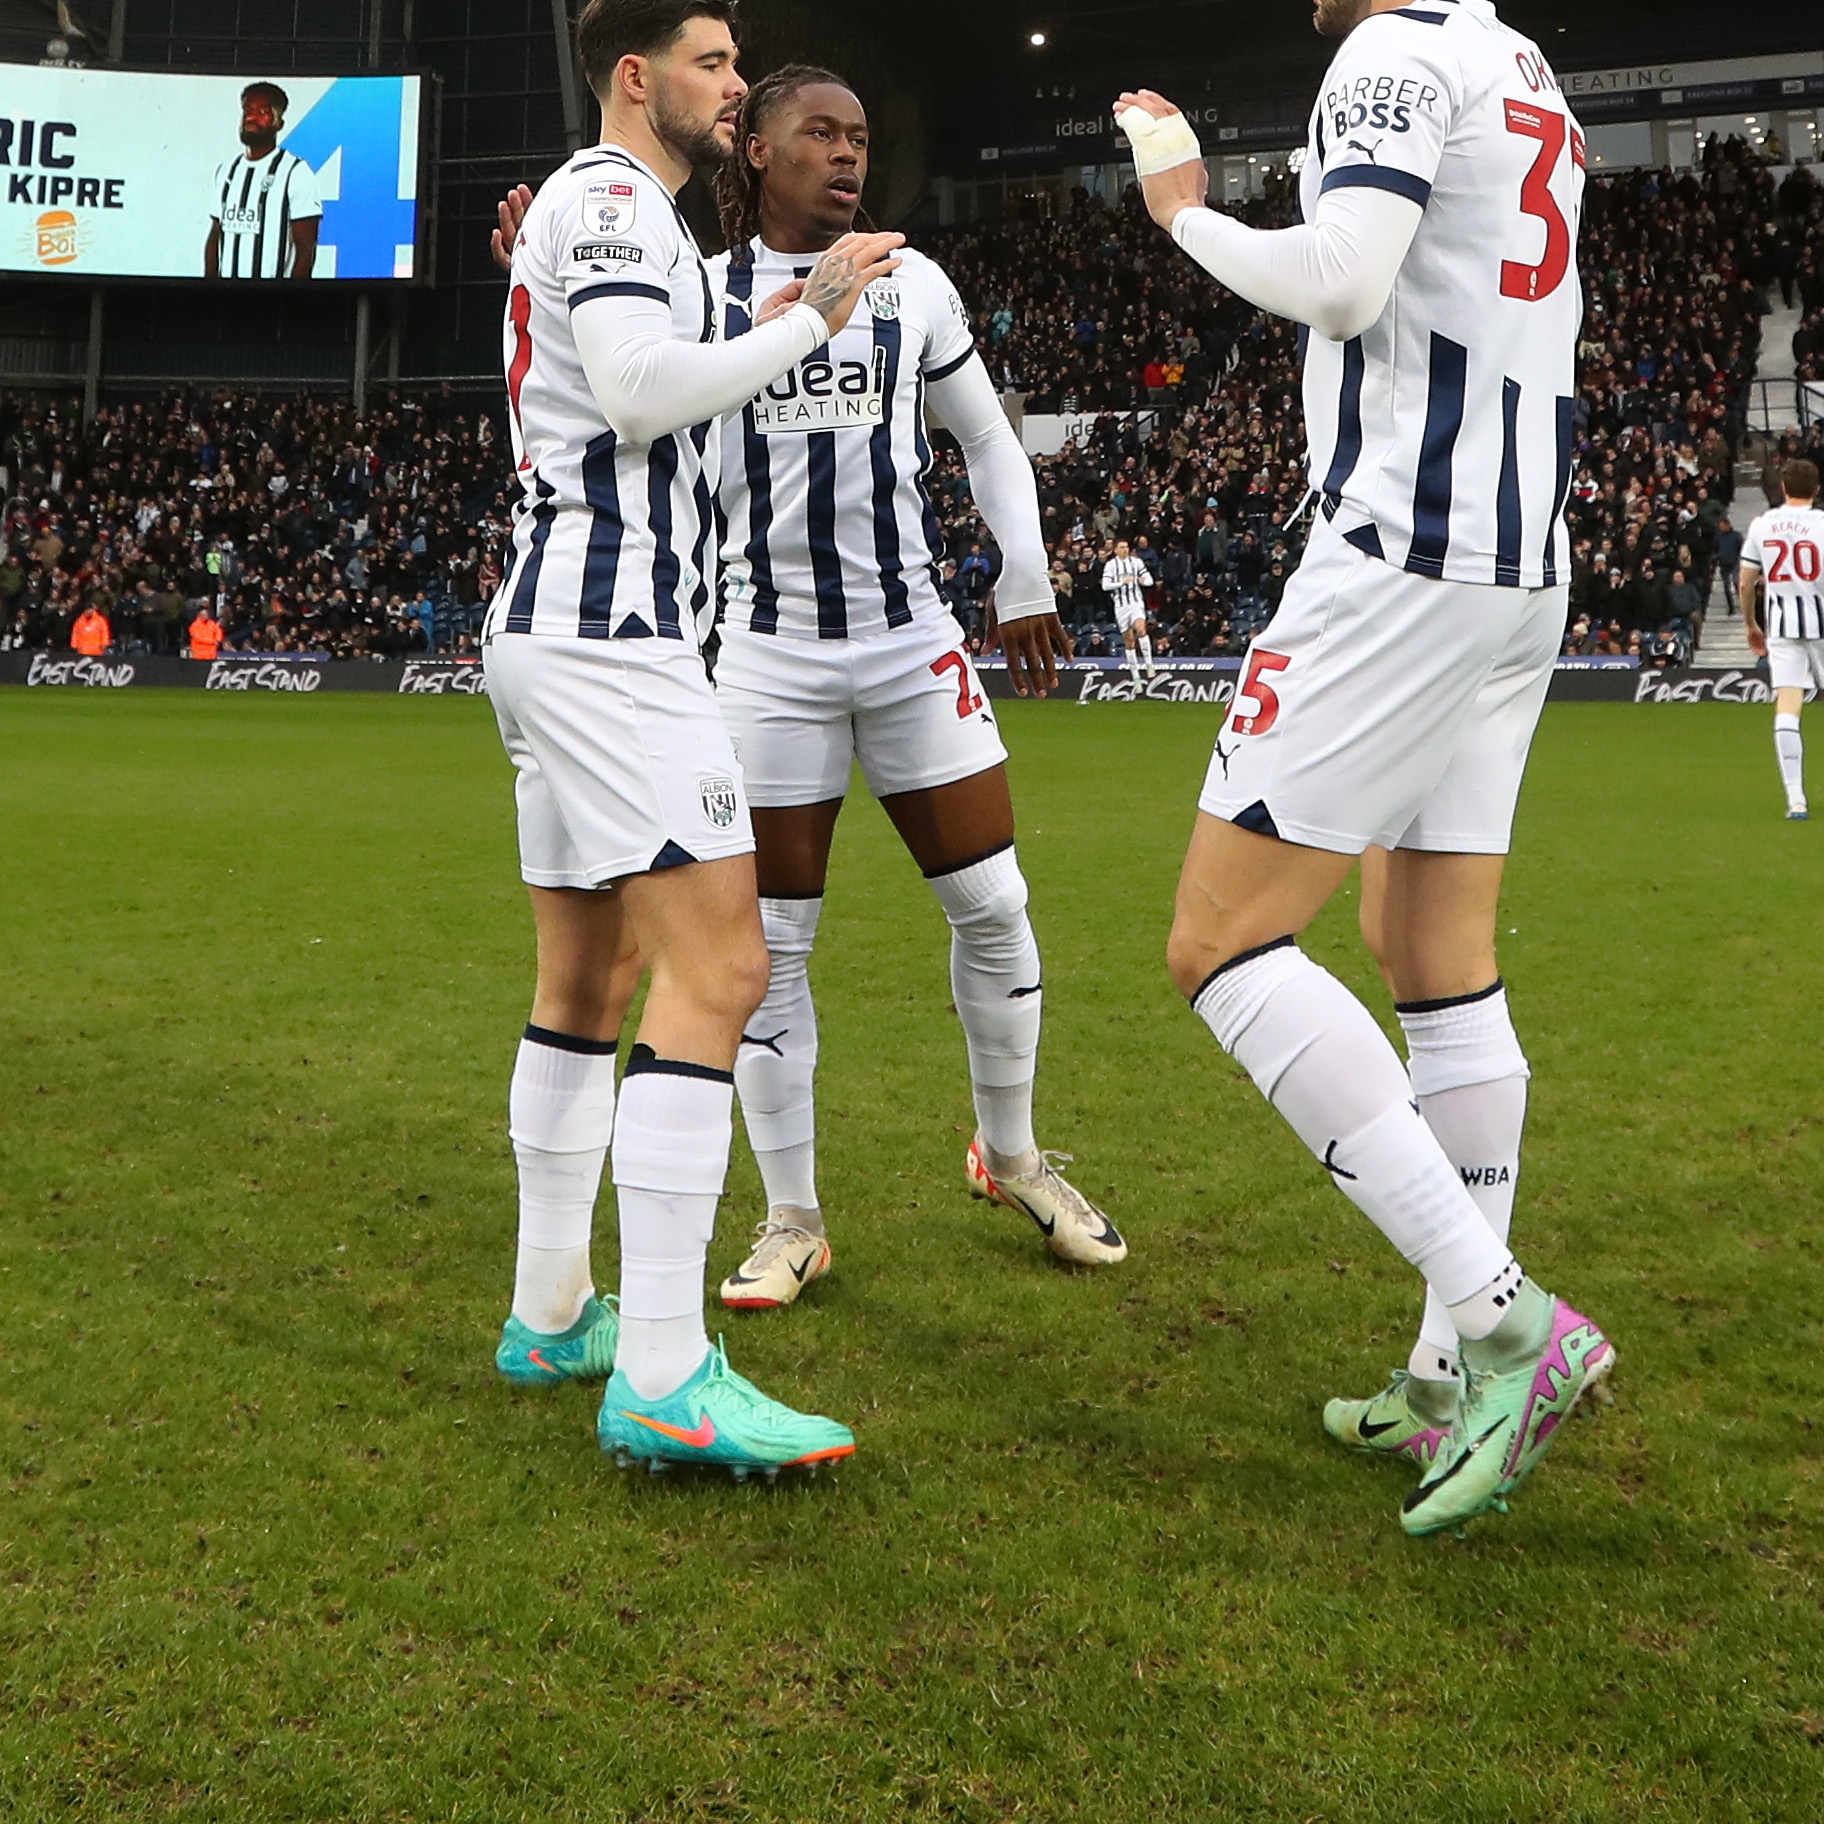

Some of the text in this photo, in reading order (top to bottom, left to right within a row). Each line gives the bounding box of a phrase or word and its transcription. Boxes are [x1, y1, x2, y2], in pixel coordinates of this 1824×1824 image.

[1327, 77, 1438, 120] BARBER
[1055, 117, 1103, 137] ideal
[1335, 103, 1410, 138] BOSS
[8, 173, 125, 209] KIPRE
[588, 185, 631, 195] sky bet
[222, 204, 260, 222] ideal
[599, 224, 616, 232] EFL
[38, 233, 75, 256] Boi
[576, 247, 640, 262] TOGETHER
[756, 398, 882, 426] HEATING
[1772, 521, 1810, 536] REACH
[1763, 539, 1821, 583] 20
[27, 653, 135, 688] EAST STAND
[255, 663, 322, 691] STAND
[702, 782, 733, 794] ALBION
[1460, 1166, 1509, 1186] WBA
